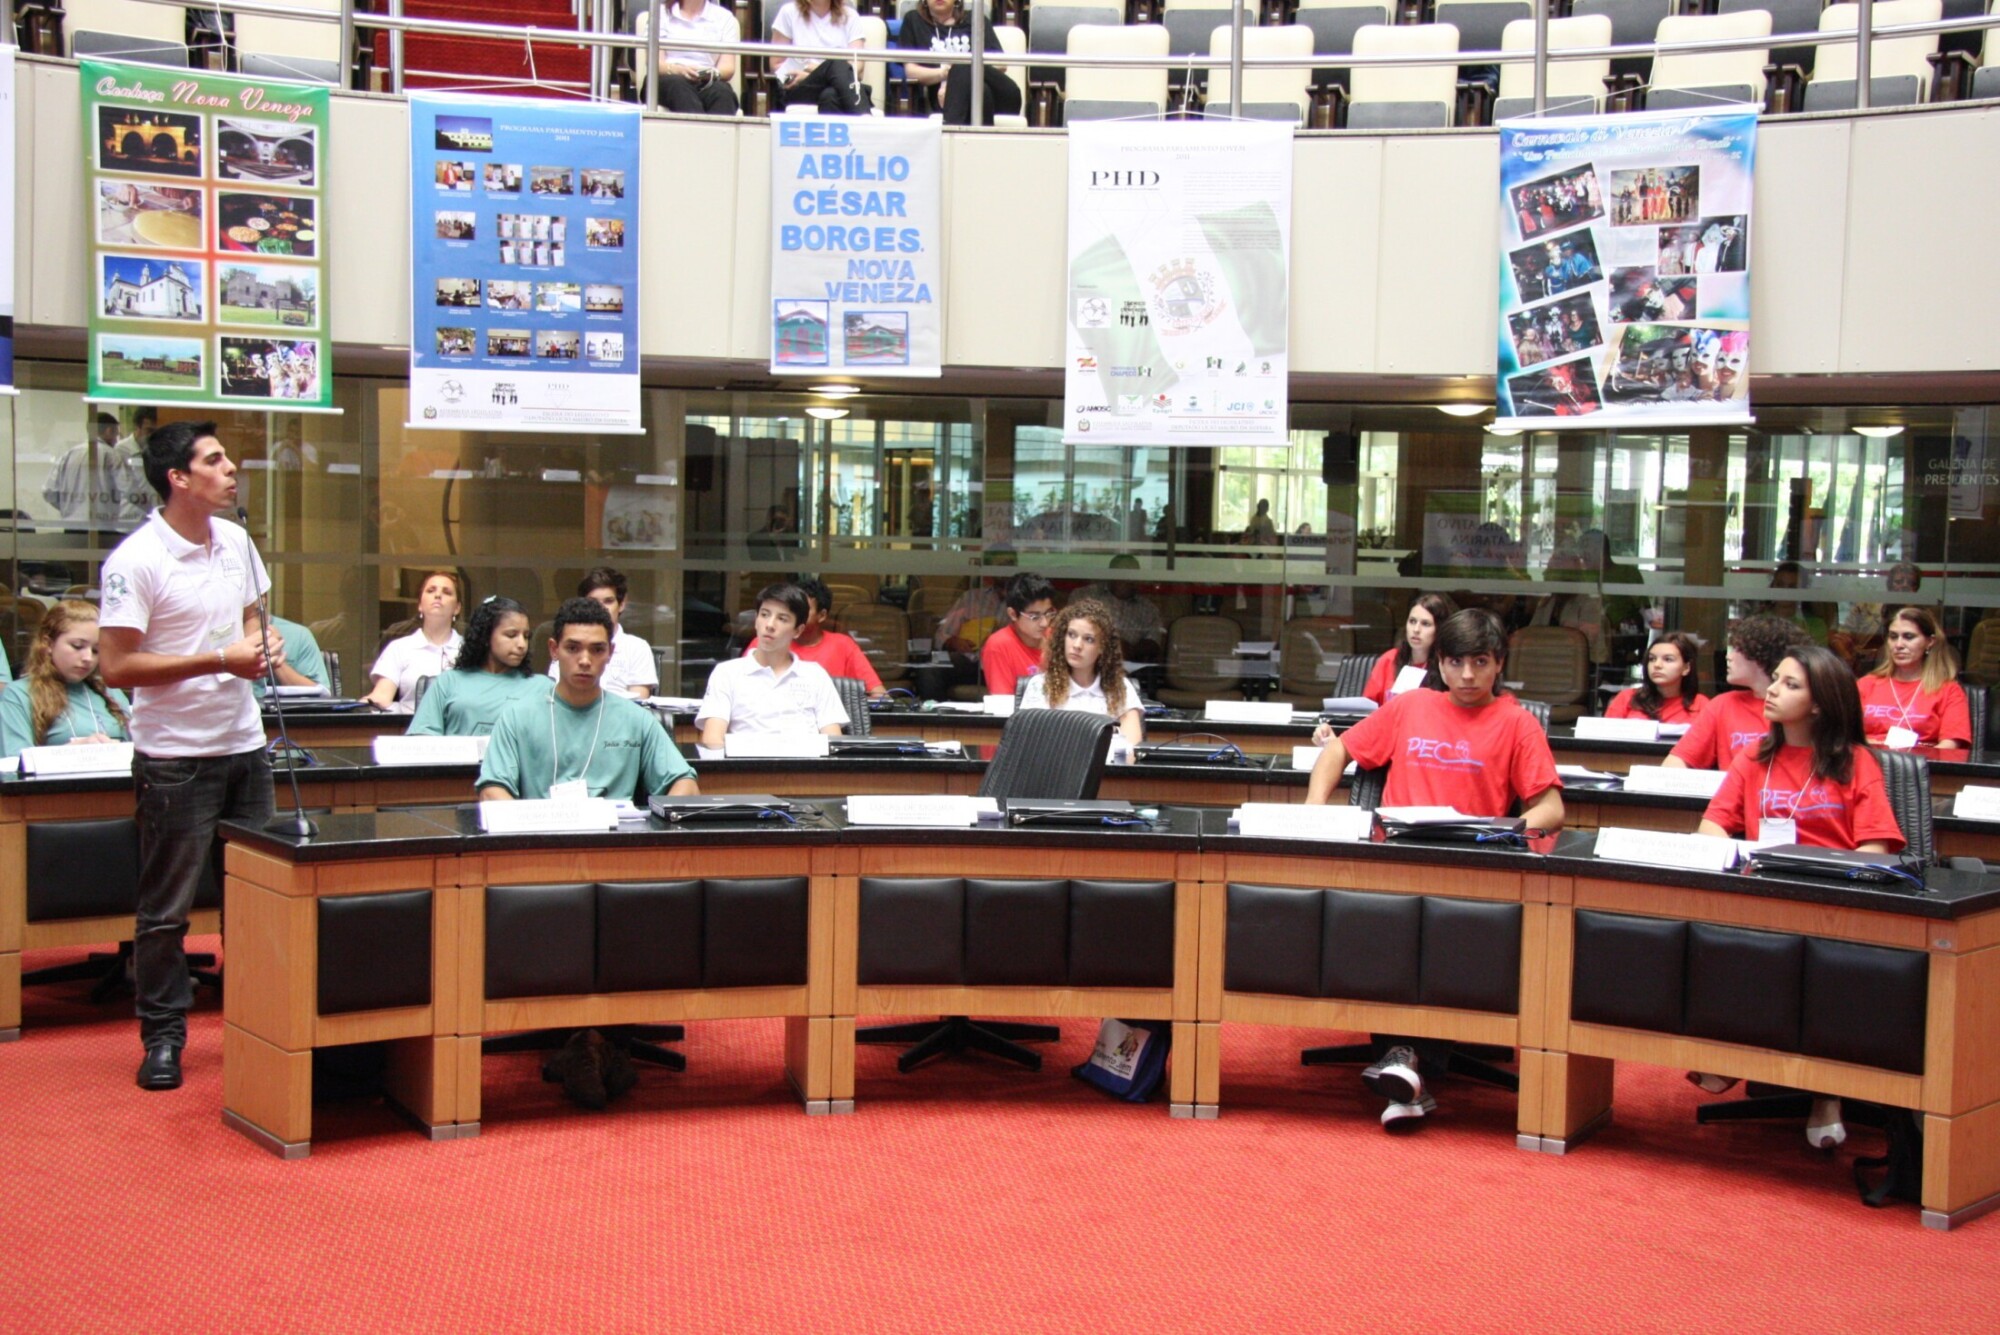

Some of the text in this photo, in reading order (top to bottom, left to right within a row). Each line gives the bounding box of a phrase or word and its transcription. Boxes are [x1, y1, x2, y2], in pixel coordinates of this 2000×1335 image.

[96, 76, 313, 123] Conheça Nova Veneza
[500, 124, 625, 138] PROGRAMA PARLAMENTO JOVEM
[796, 148, 911, 182] ABÍLIO
[1090, 170, 1160, 187] PHD
[792, 183, 907, 217] CÉSAR
[781, 225, 925, 253] BORGES.
[847, 259, 916, 281] NOVA
[825, 281, 933, 304] VENEZA
[1227, 402, 1246, 411] JCI
[1928, 458, 1997, 470] GALERIA DE
[1924, 474, 2000, 486] PRESIDENTES
[1865, 704, 1912, 721] PEC
[1406, 737, 1464, 764] PEC
[1760, 787, 1818, 812] PEC
